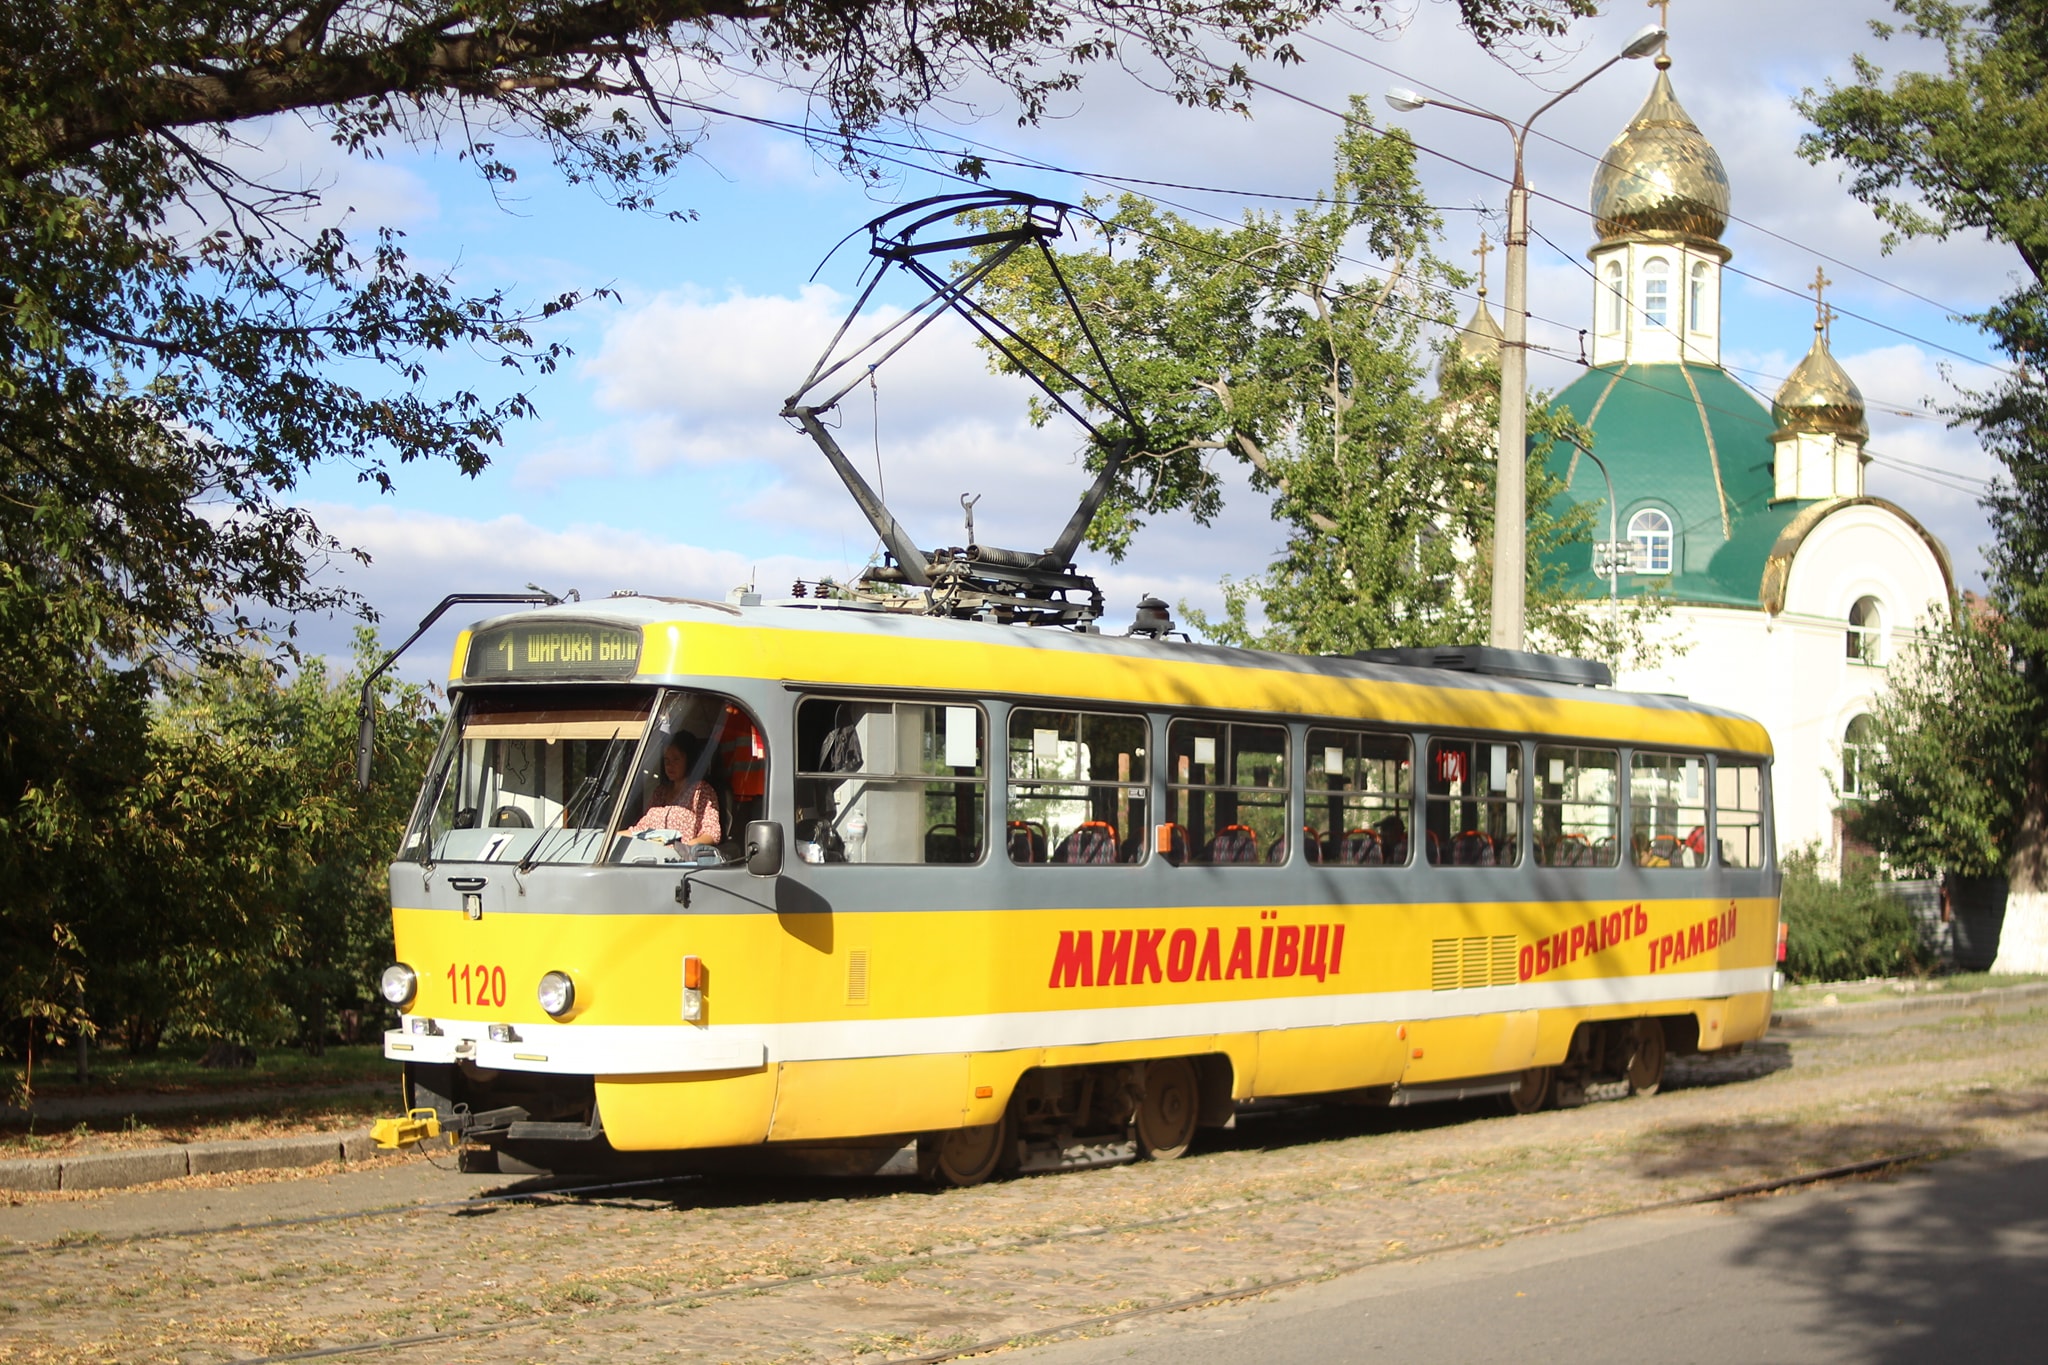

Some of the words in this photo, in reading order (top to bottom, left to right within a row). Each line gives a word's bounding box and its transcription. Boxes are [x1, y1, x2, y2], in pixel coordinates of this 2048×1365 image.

[499, 631, 514, 671] 1
[528, 633, 592, 662] ШИРОКА
[1436, 749, 1467, 783] 1120
[485, 838, 504, 862] 1
[1049, 910, 1345, 988] МИКОЛАЇВЦІ
[1519, 903, 1648, 982] ОБИРАЮТЬ
[1648, 900, 1737, 973] ТРАМВАЙ
[447, 963, 506, 1008] 1120
